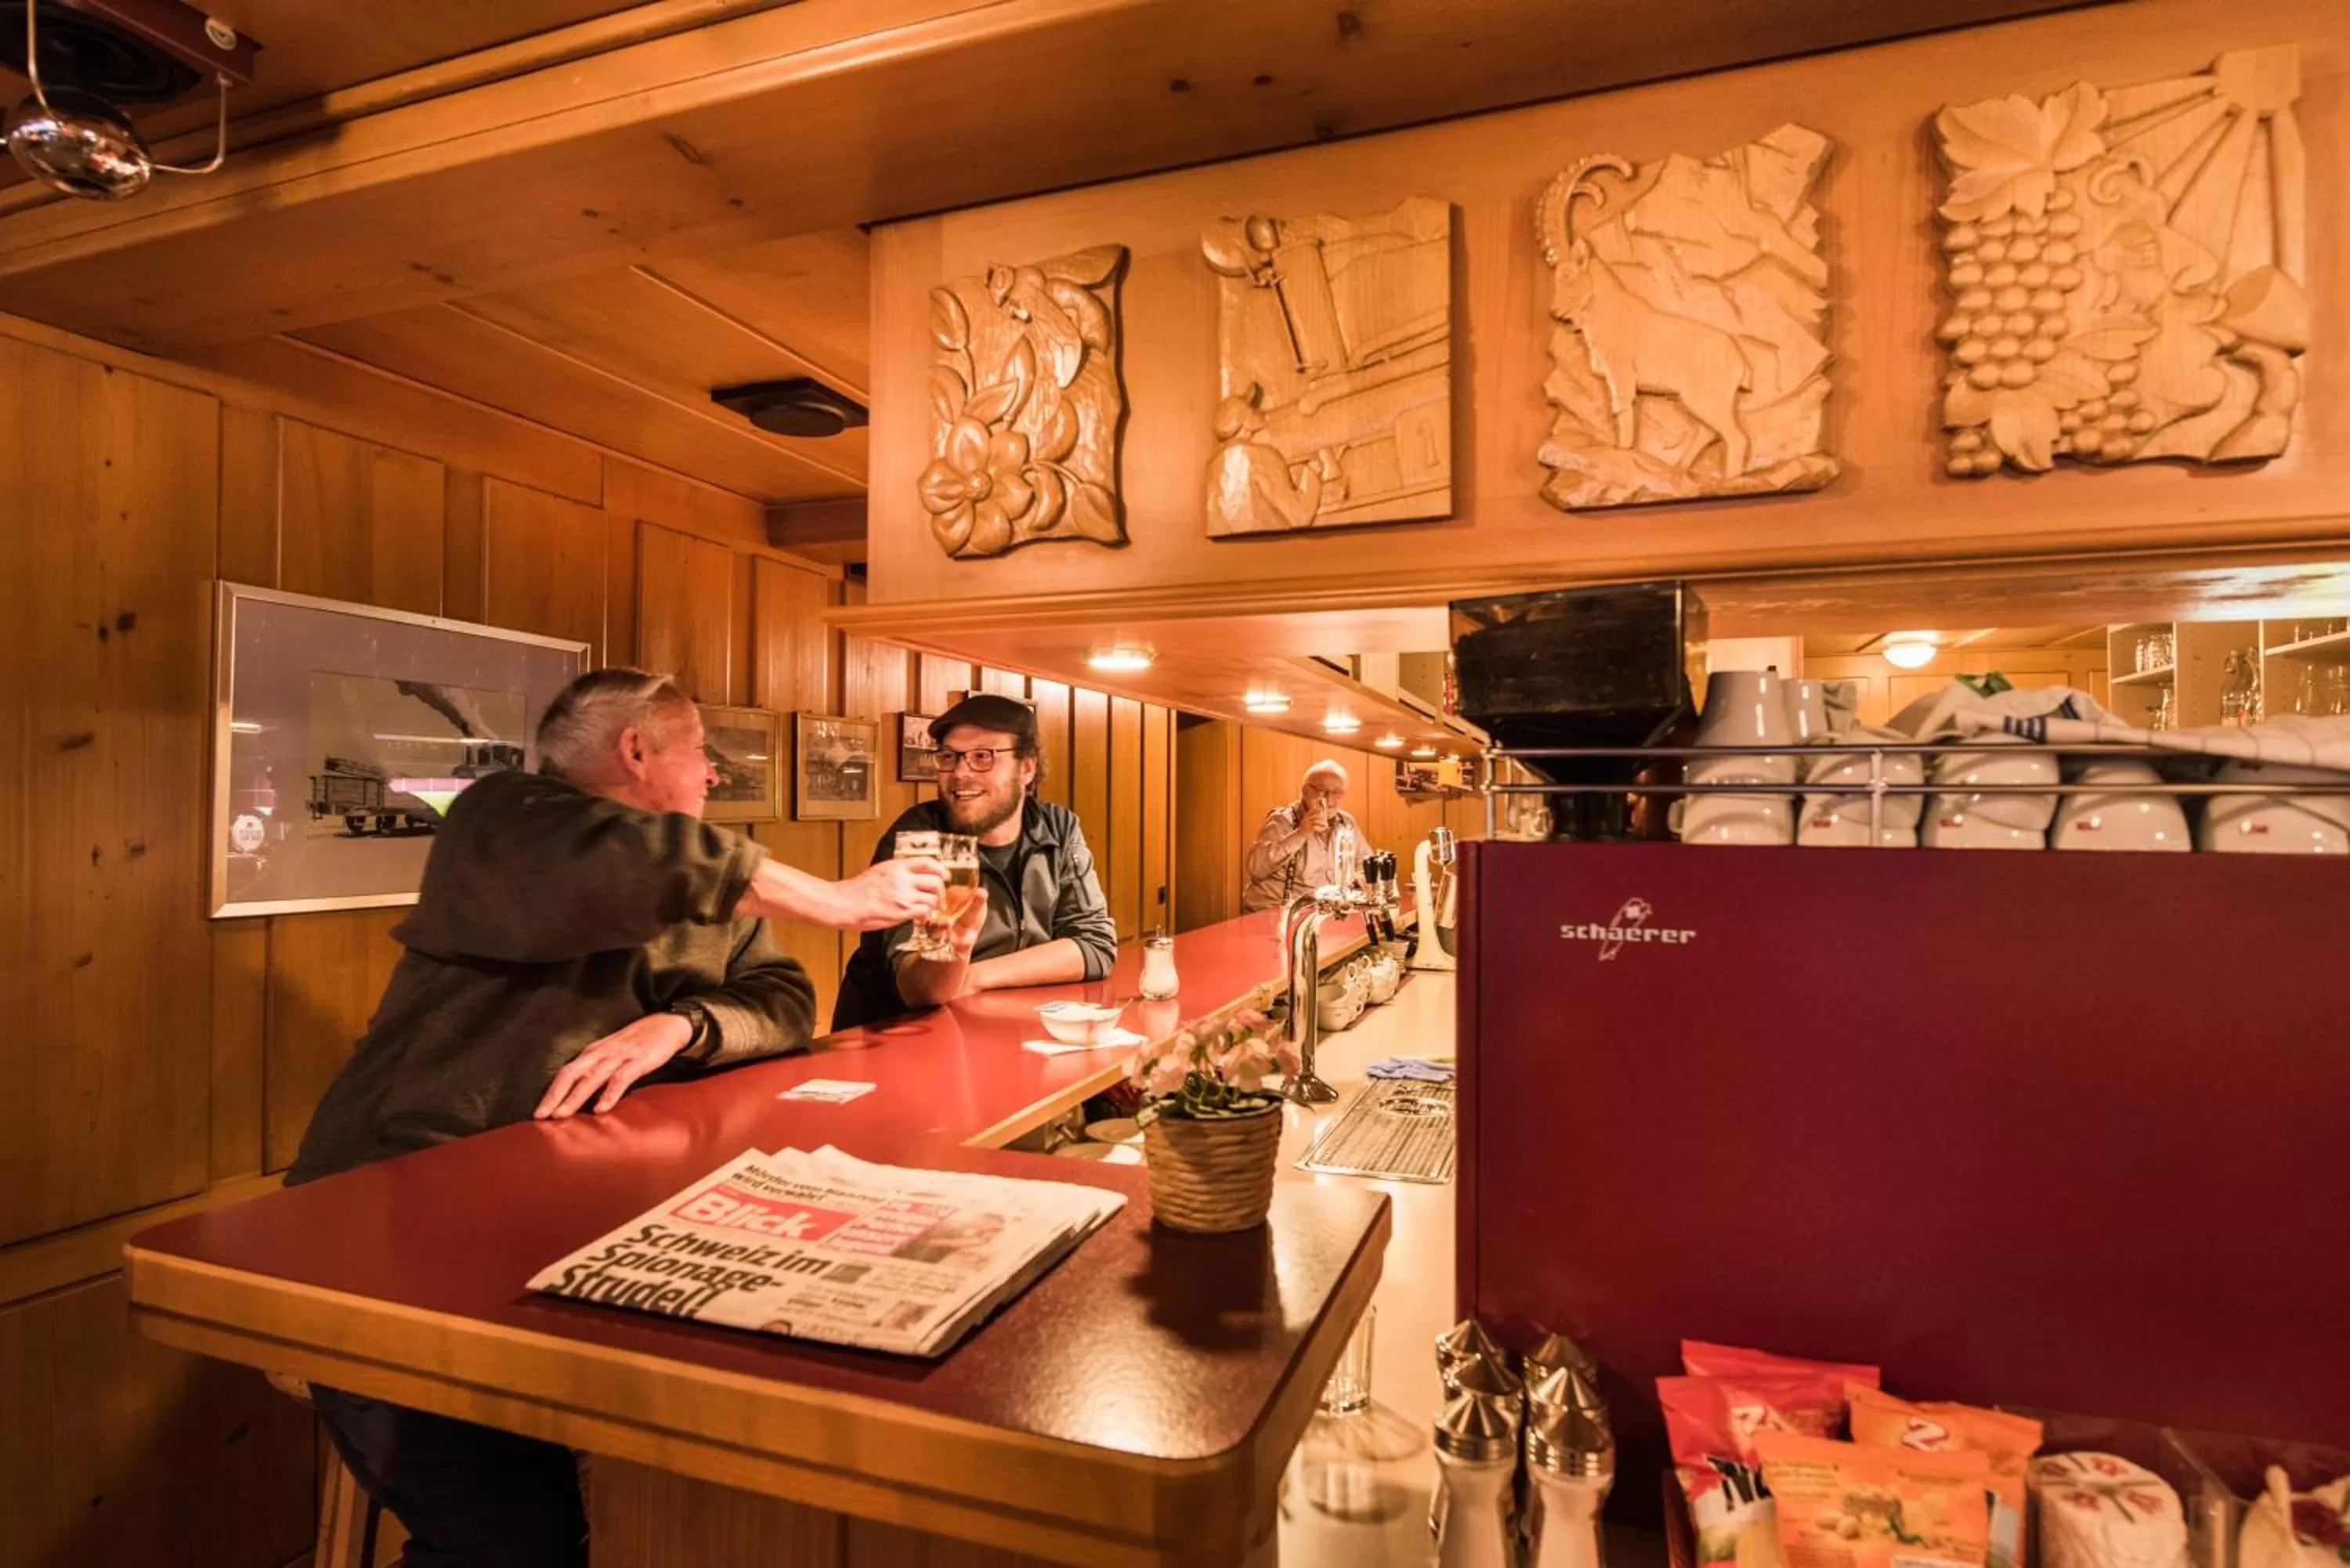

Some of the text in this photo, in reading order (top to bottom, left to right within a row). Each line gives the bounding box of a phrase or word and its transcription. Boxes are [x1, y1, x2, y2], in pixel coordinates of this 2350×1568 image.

[1560, 923, 1697, 944] schaerer
[675, 1191, 817, 1238] Blick
[586, 1243, 783, 1292] Spionage-
[624, 1224, 781, 1266] Schweiz
[772, 1249, 833, 1275] im
